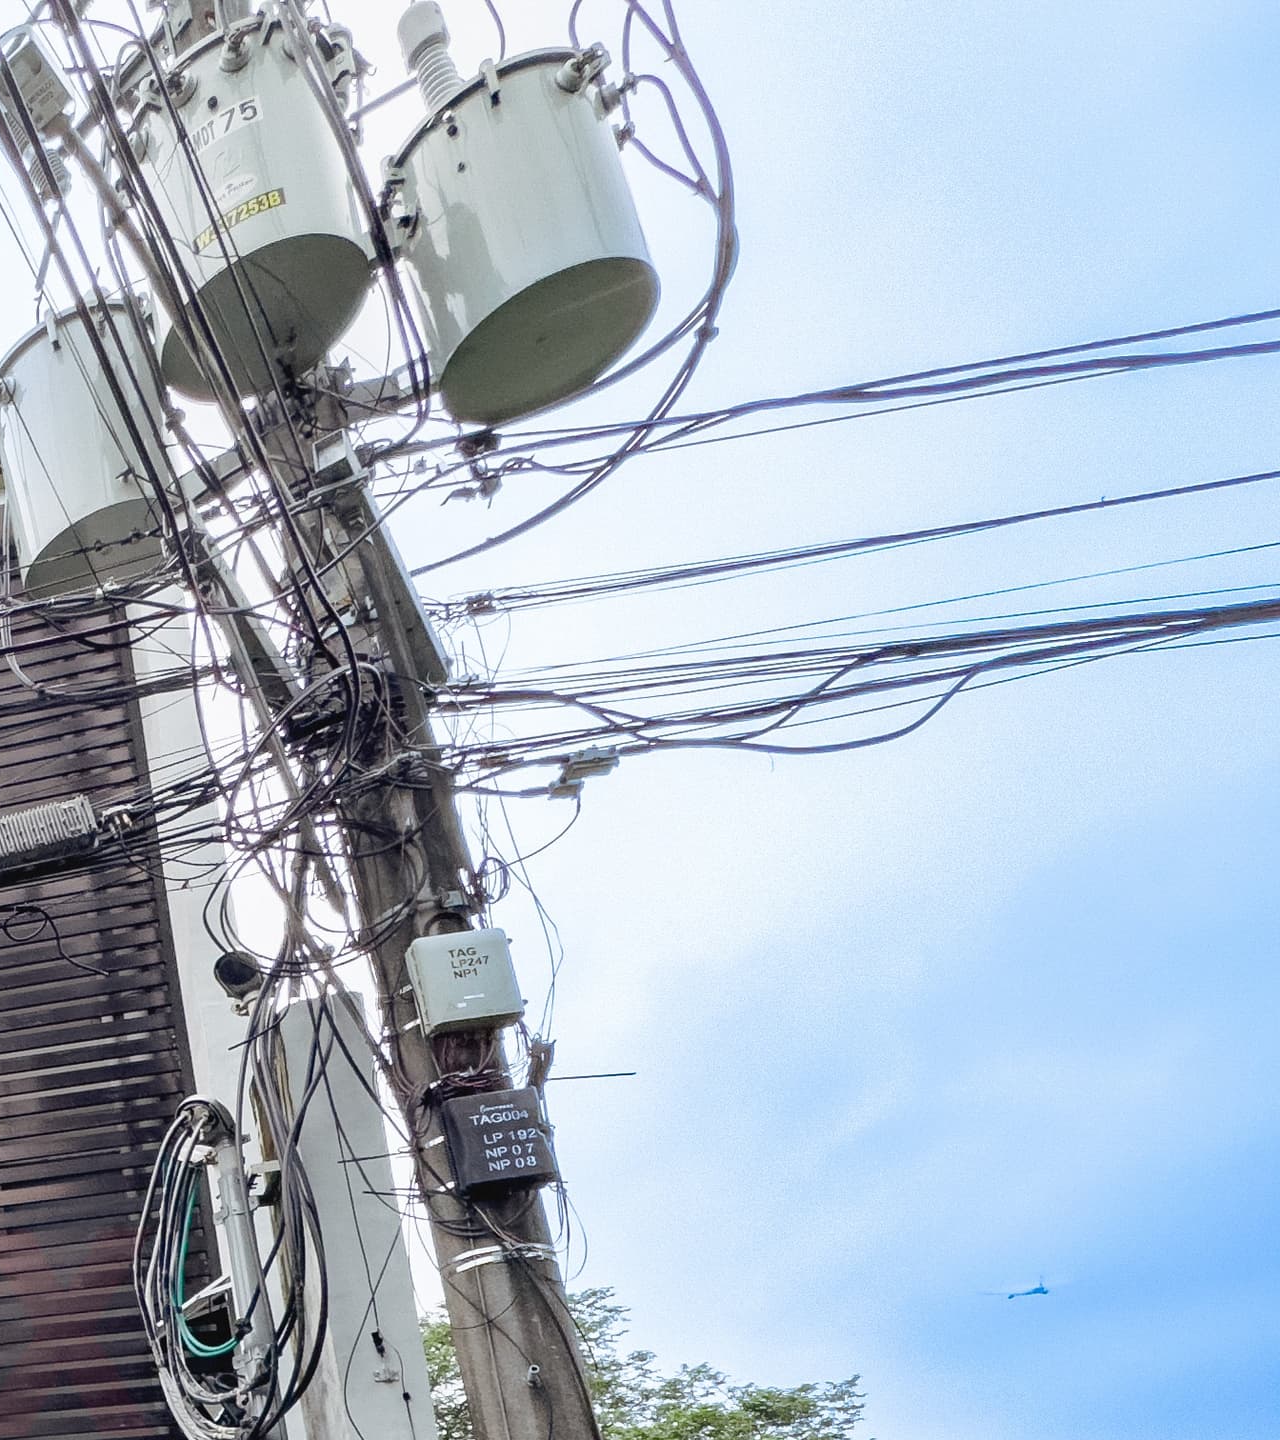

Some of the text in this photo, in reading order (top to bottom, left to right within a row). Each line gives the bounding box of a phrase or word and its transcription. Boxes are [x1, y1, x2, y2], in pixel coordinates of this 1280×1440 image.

[219, 99, 258, 134] 75
[448, 947, 477, 959] TAG
[451, 955, 489, 969] LP247
[453, 968, 478, 979] NP1
[469, 1110, 529, 1126] TAG004
[483, 1128, 537, 1144] LP 192
[485, 1146, 508, 1159] NP
[488, 1159, 511, 1171] NP
